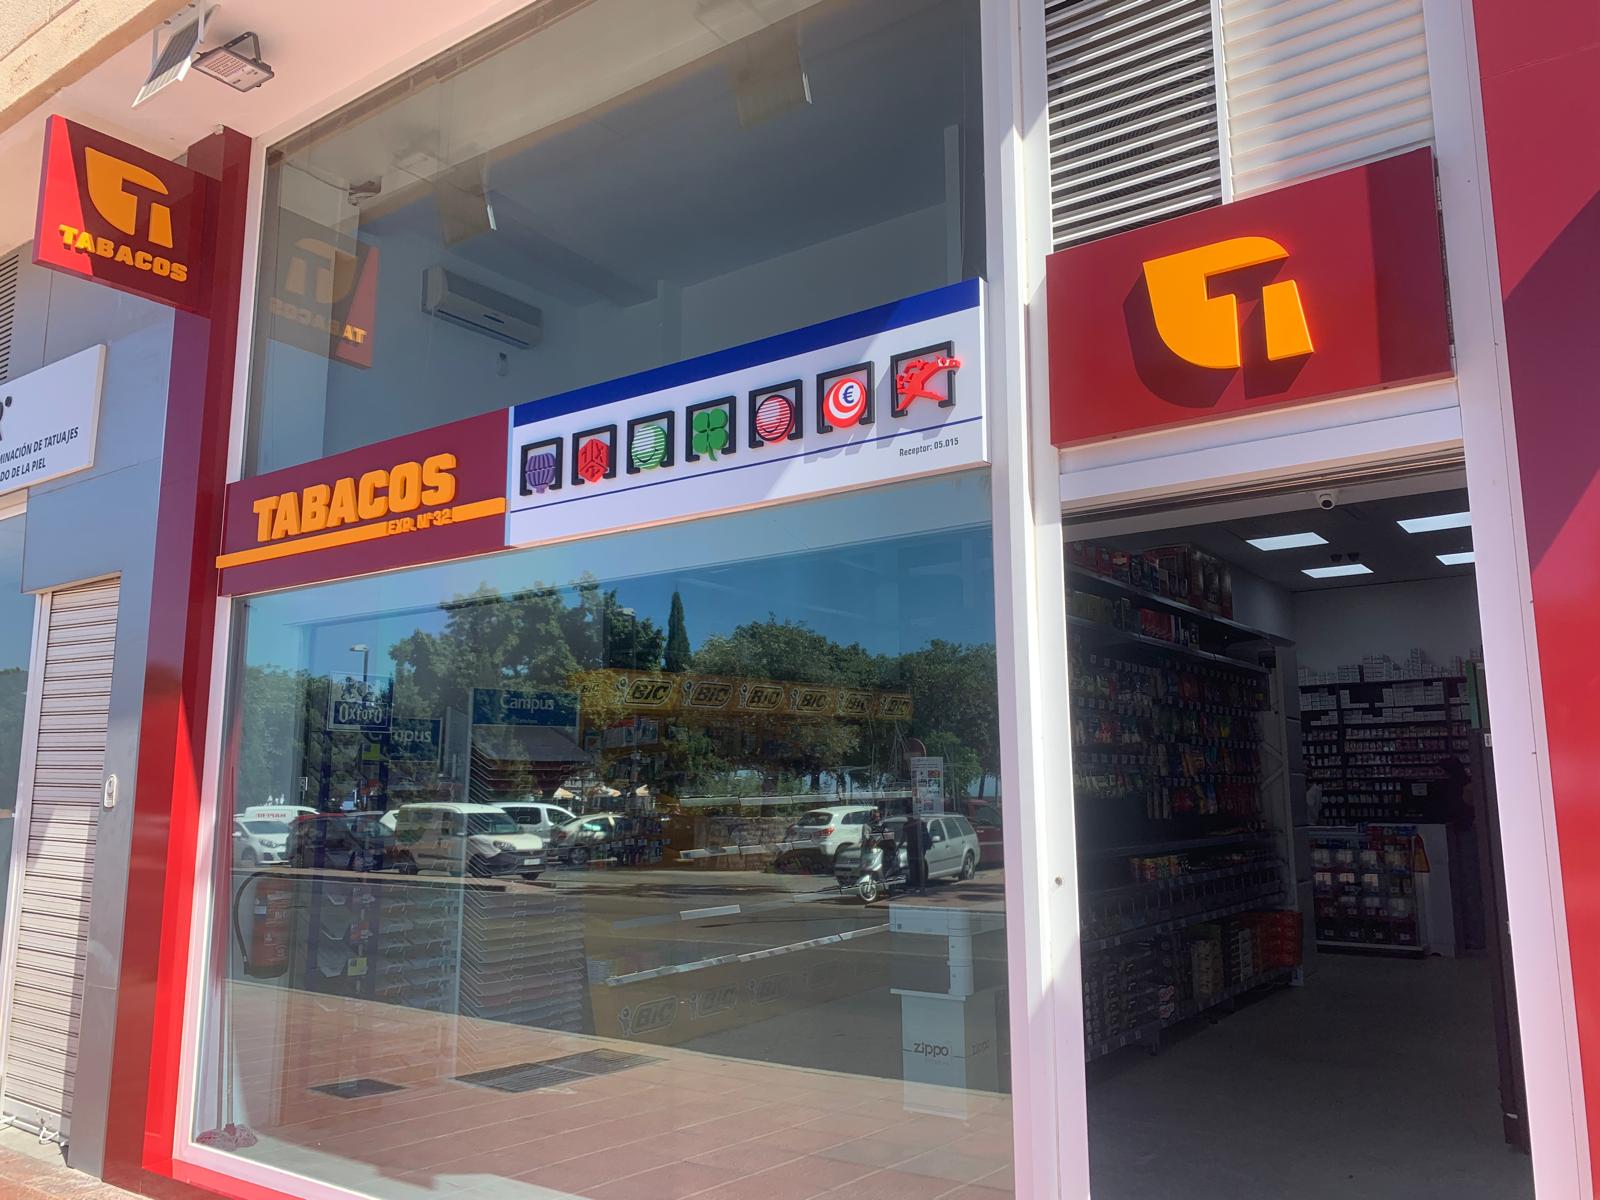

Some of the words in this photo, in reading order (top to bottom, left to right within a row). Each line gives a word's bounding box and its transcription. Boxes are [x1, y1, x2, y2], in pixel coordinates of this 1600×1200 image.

[59, 223, 188, 282] TABACOS
[33, 439, 42, 452] DE
[44, 427, 79, 448] TATUAJES
[899, 444, 933, 457] Receptor:
[934, 437, 959, 449] 05.015
[11, 466, 21, 478] DE
[21, 462, 30, 475] LA
[31, 457, 46, 472] PIEL
[252, 452, 457, 542] TABACOS
[500, 692, 555, 713] Campus
[631, 684, 669, 700] BIC
[694, 687, 730, 702] BIC
[751, 690, 779, 705] BIC
[800, 693, 827, 707] BIC
[338, 702, 384, 724] Oxford
[637, 1002, 674, 1028] BIC
[912, 1041, 950, 1058] zippo
